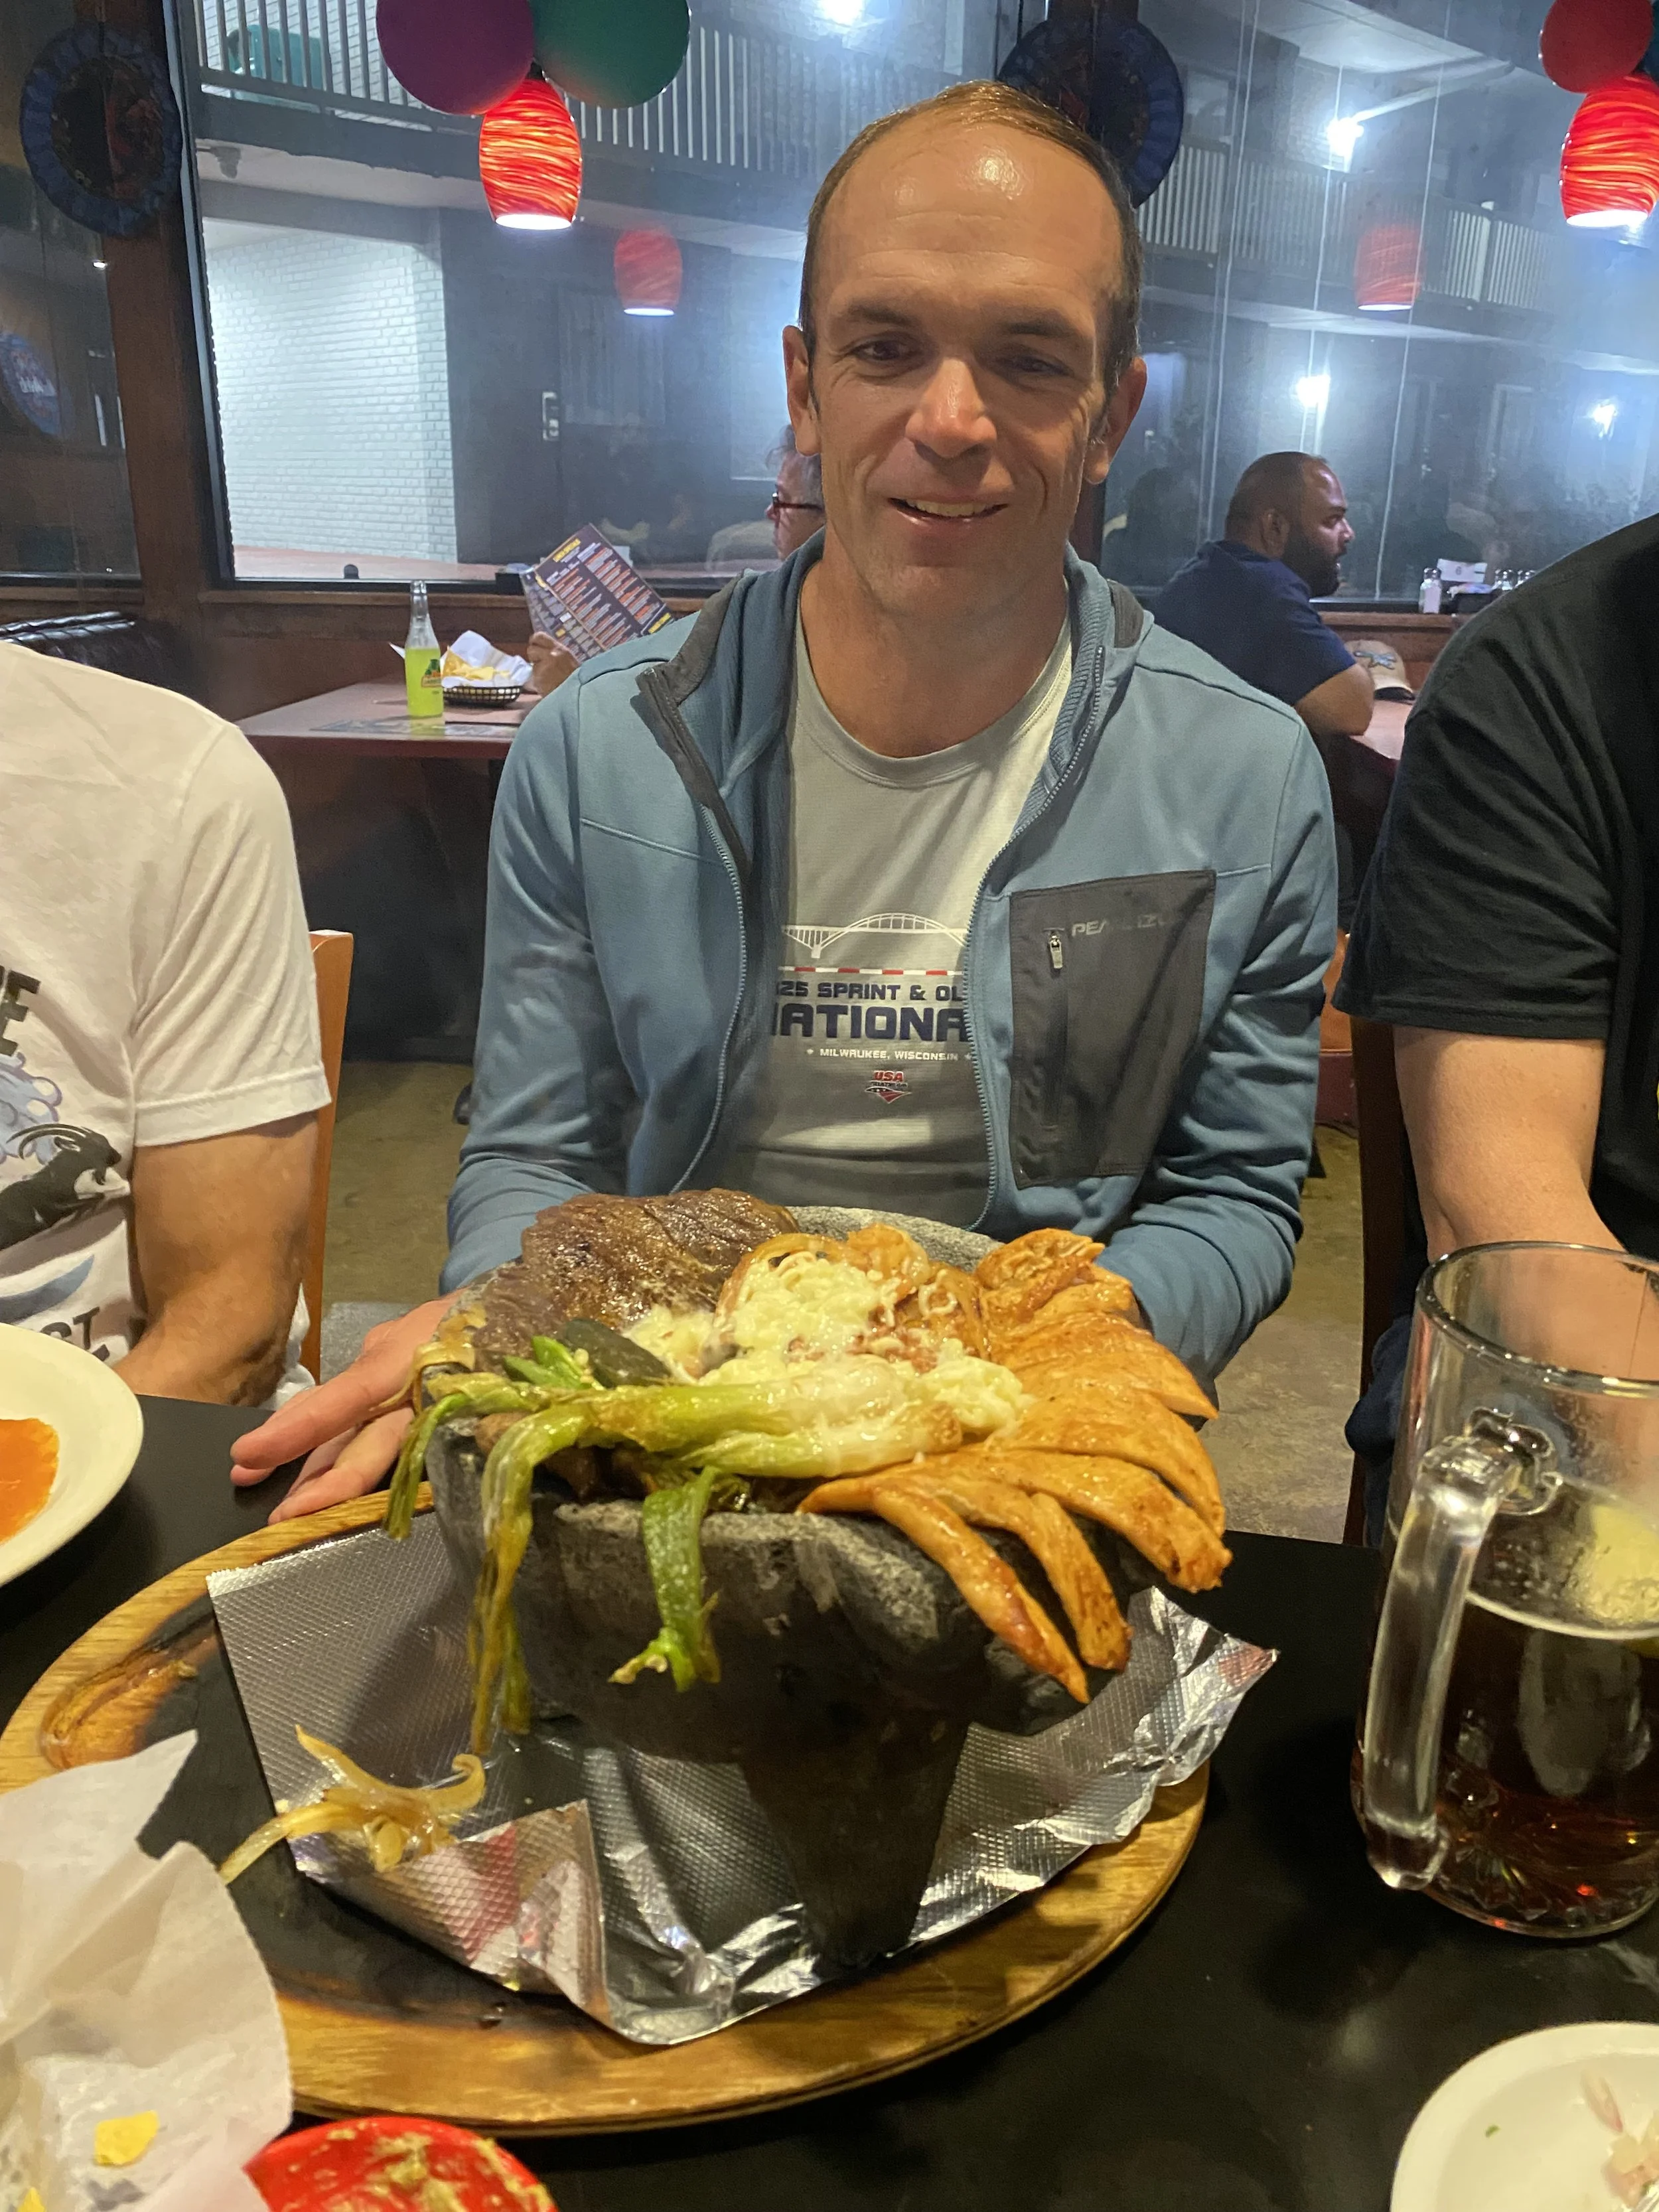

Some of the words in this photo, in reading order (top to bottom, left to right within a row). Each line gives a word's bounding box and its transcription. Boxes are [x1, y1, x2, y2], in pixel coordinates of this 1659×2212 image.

[776, 980, 808, 997] 25
[818, 982, 901, 1000] SPRINT
[910, 985, 926, 1000] &
[936, 986, 964, 1001] OL
[0, 965, 41, 1056] E
[771, 1002, 973, 1041] ATIONA
[820, 1049, 890, 1060] MILWAUKEE,
[895, 1051, 958, 1061] WISCONSIN
[873, 1070, 904, 1082] USA
